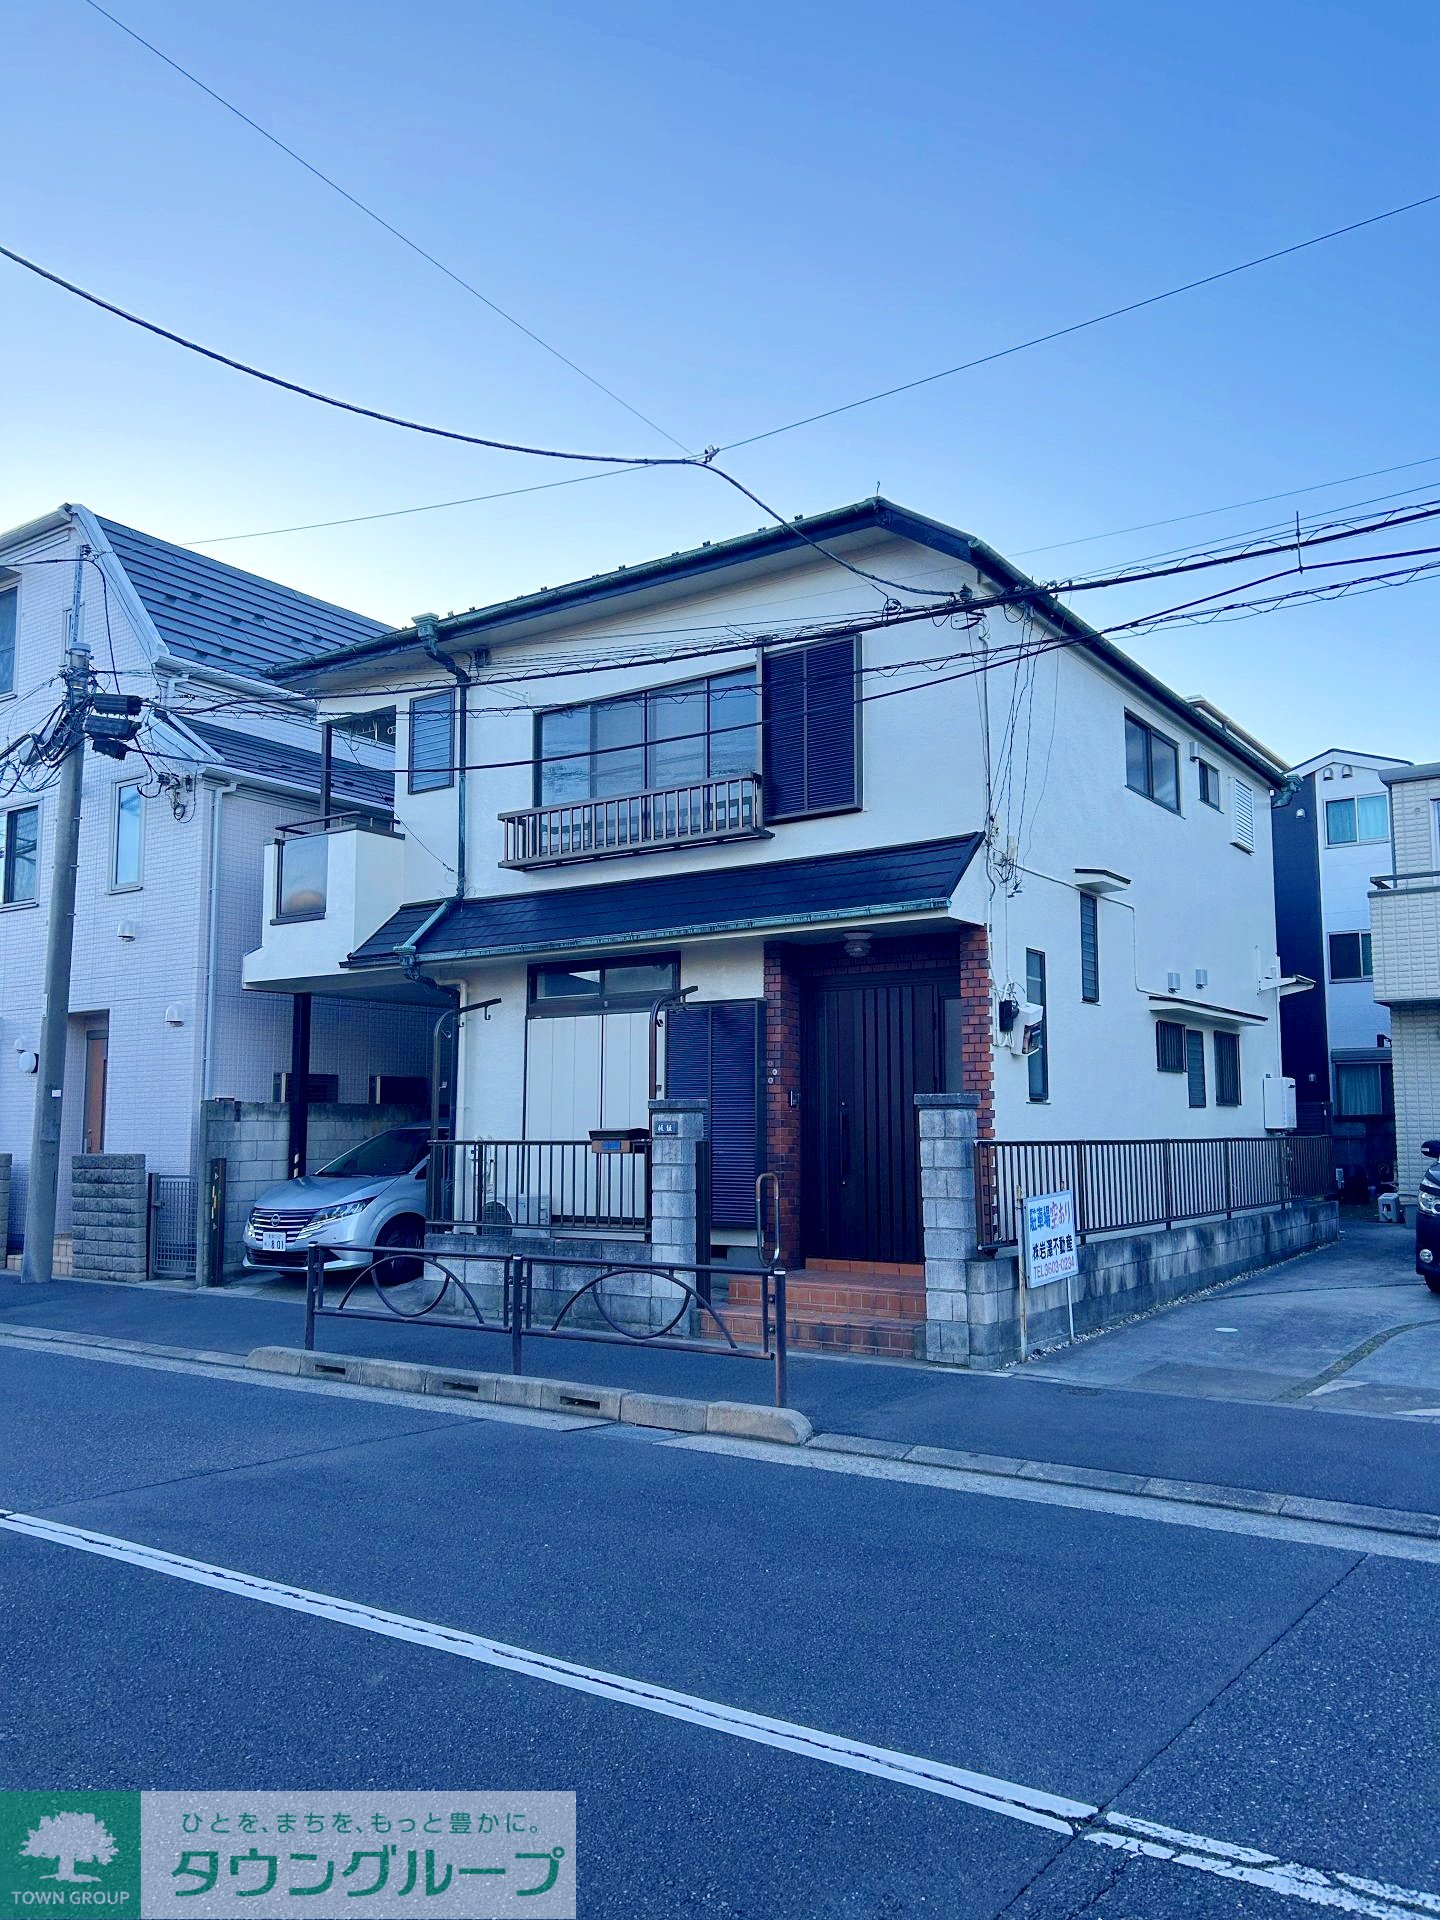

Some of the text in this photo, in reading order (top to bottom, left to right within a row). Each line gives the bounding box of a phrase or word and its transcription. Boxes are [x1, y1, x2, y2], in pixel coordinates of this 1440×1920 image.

[1029, 1201, 1071, 1231] 駐車場空あり
